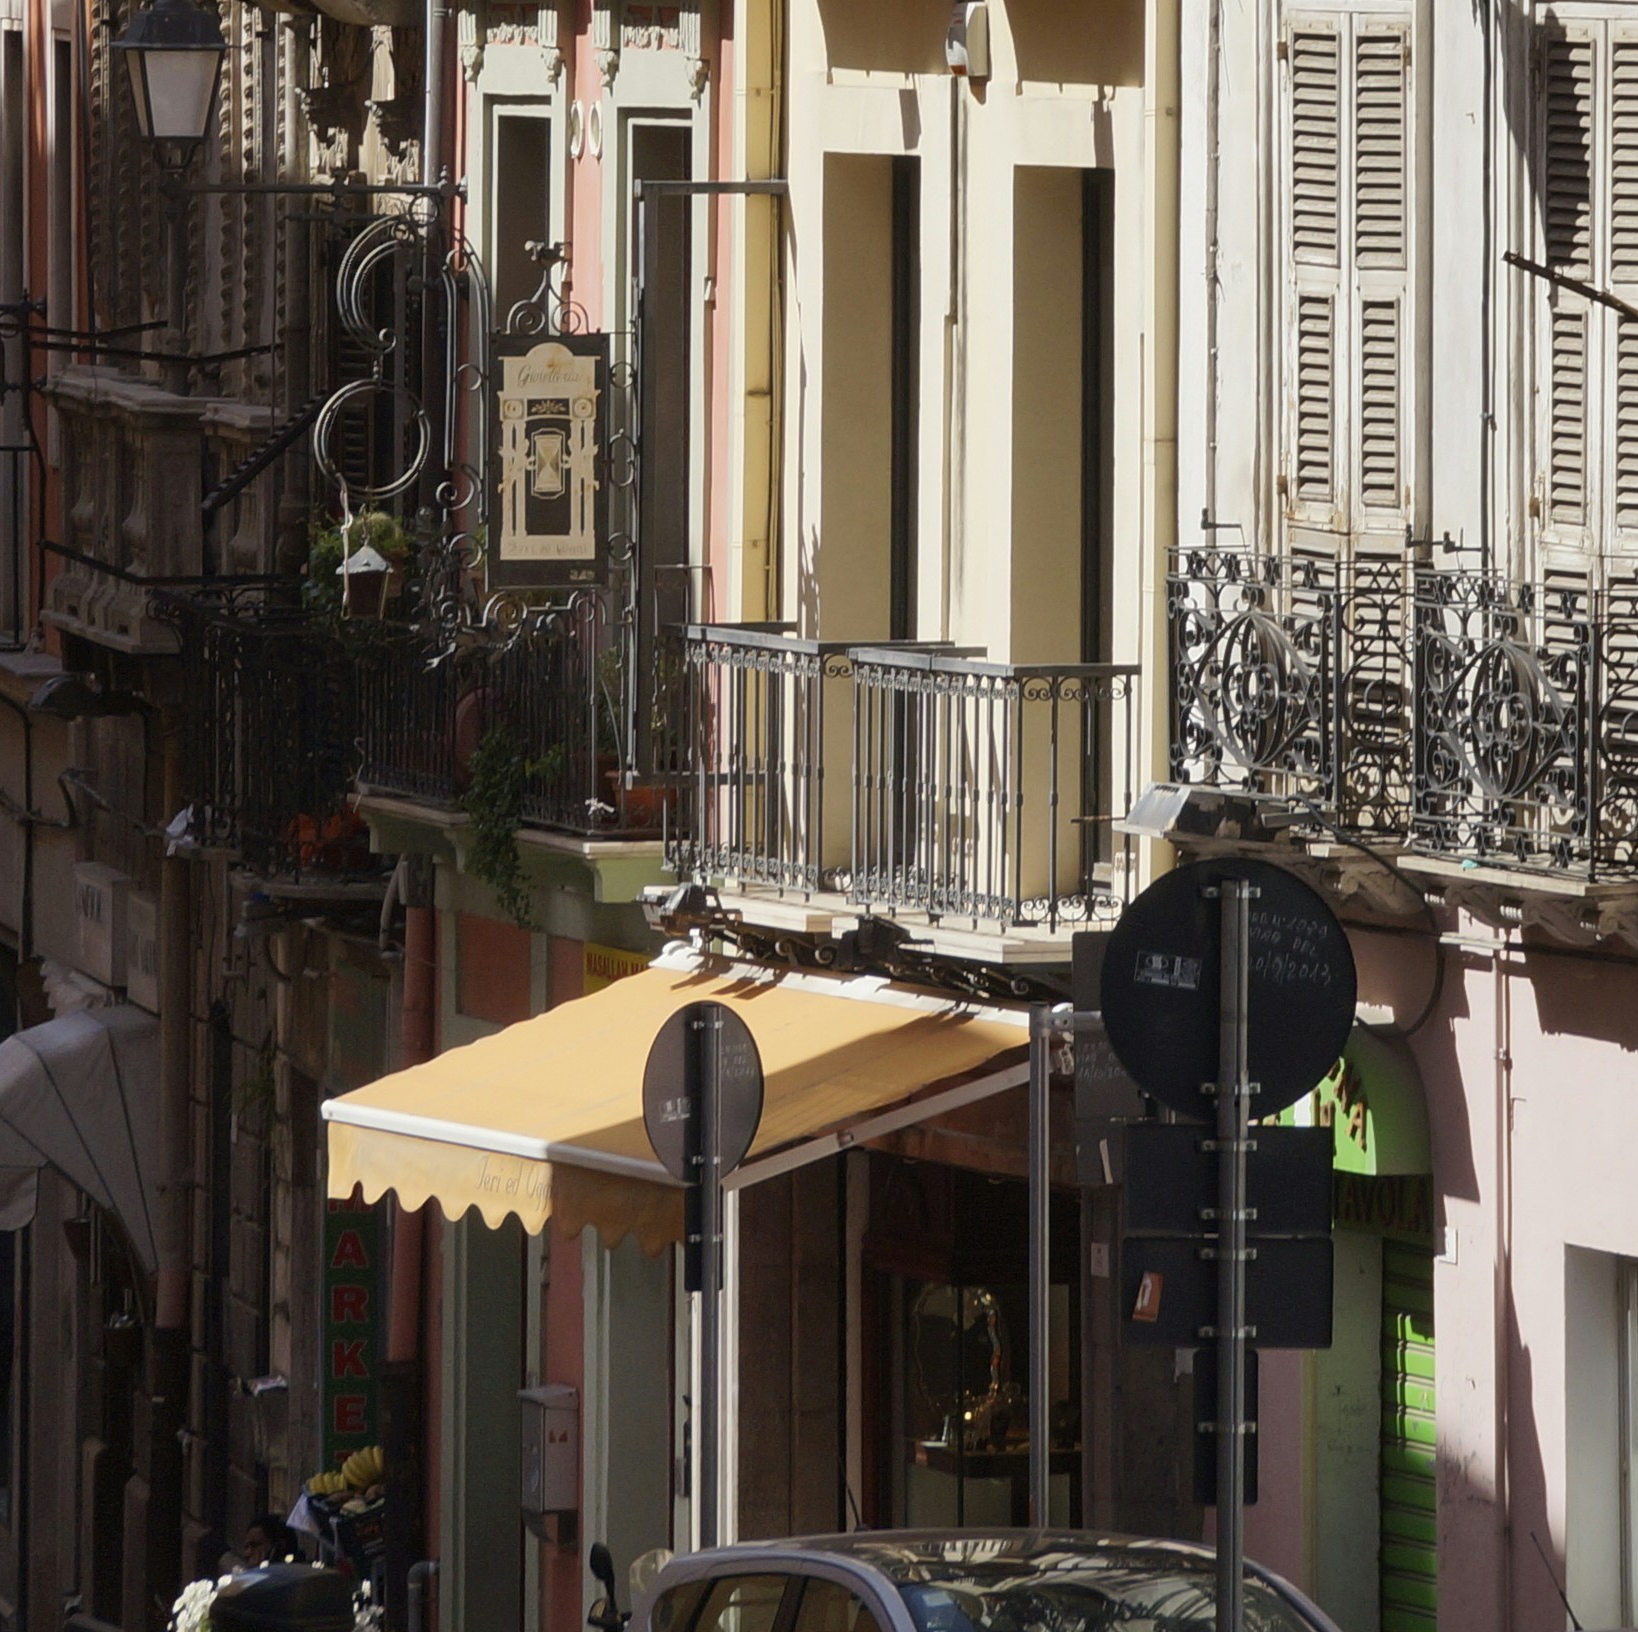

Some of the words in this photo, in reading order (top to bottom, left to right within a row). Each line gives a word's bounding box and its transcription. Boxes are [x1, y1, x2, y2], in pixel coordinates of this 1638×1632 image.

[505, 1160, 524, 1198] ed
[526, 1162, 552, 1212] Ogg
[328, 1188, 374, 1463] ARKE
